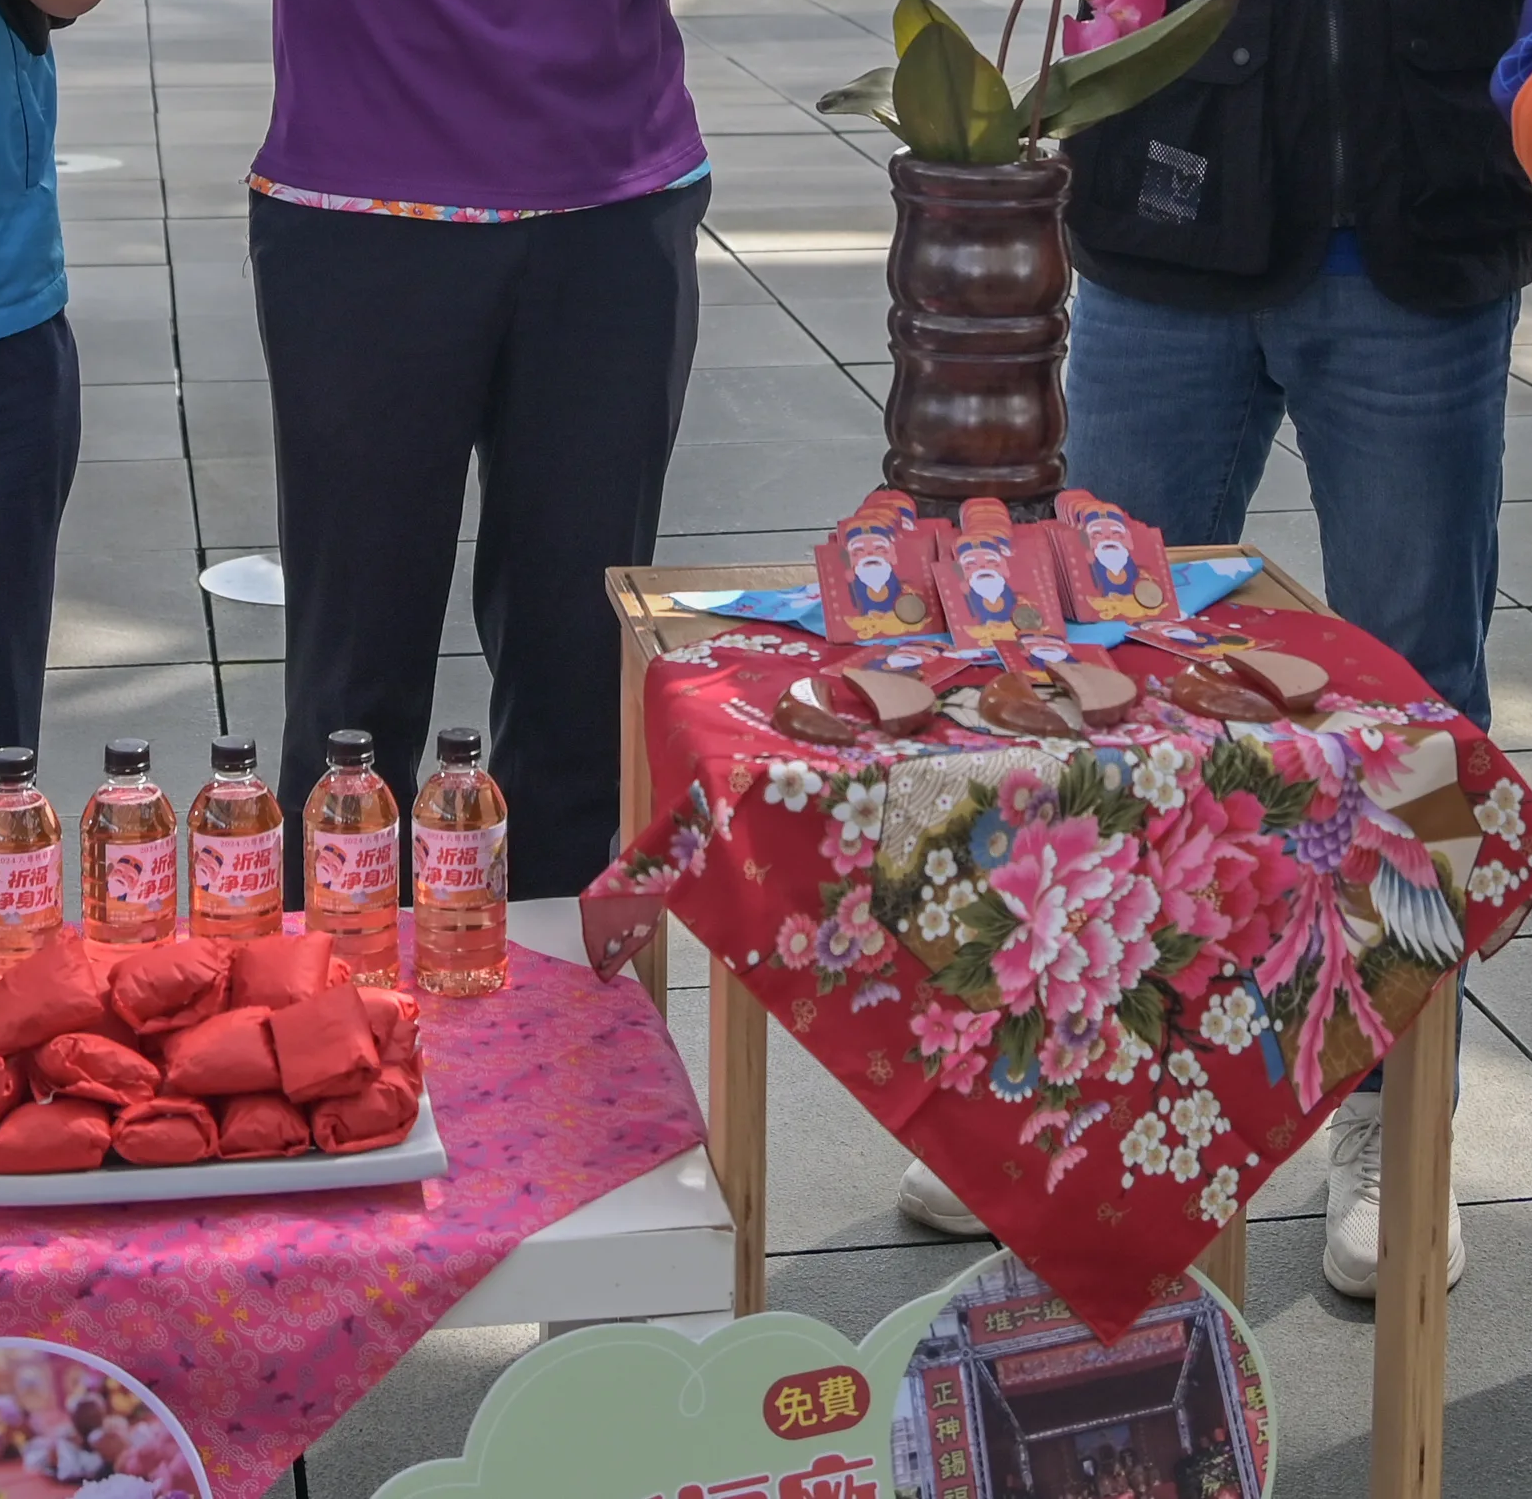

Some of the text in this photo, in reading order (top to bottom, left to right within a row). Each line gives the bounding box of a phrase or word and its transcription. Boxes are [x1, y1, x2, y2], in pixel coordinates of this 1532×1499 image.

[232, 847, 272, 872] 祈福
[355, 844, 392, 868] 祈福
[436, 846, 479, 865] 祈福
[8, 864, 50, 889] 祈福
[773, 1374, 861, 1432] 免費
